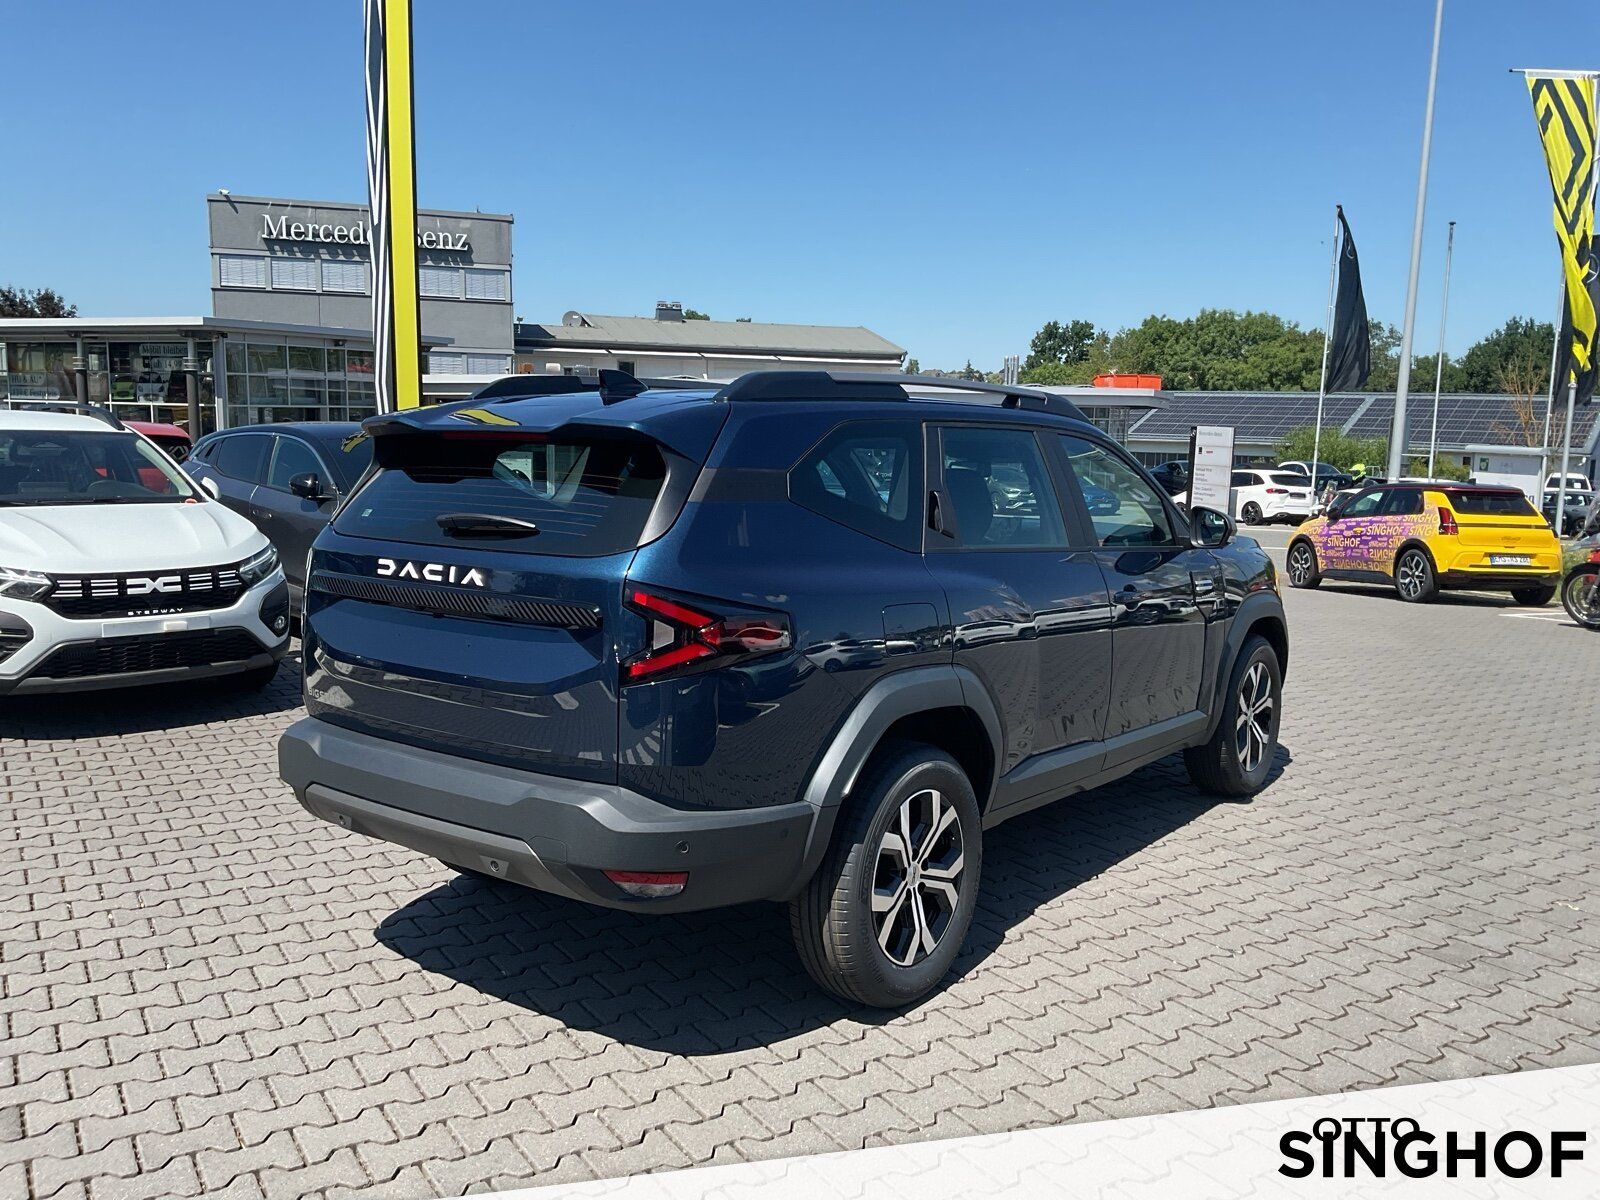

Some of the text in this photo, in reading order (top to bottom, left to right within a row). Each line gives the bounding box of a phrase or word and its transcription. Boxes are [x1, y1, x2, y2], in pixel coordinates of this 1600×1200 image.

[1402, 513, 1440, 523] SINGHO
[1327, 537, 1361, 547] SINGHOF
[377, 558, 484, 587] DACIA
